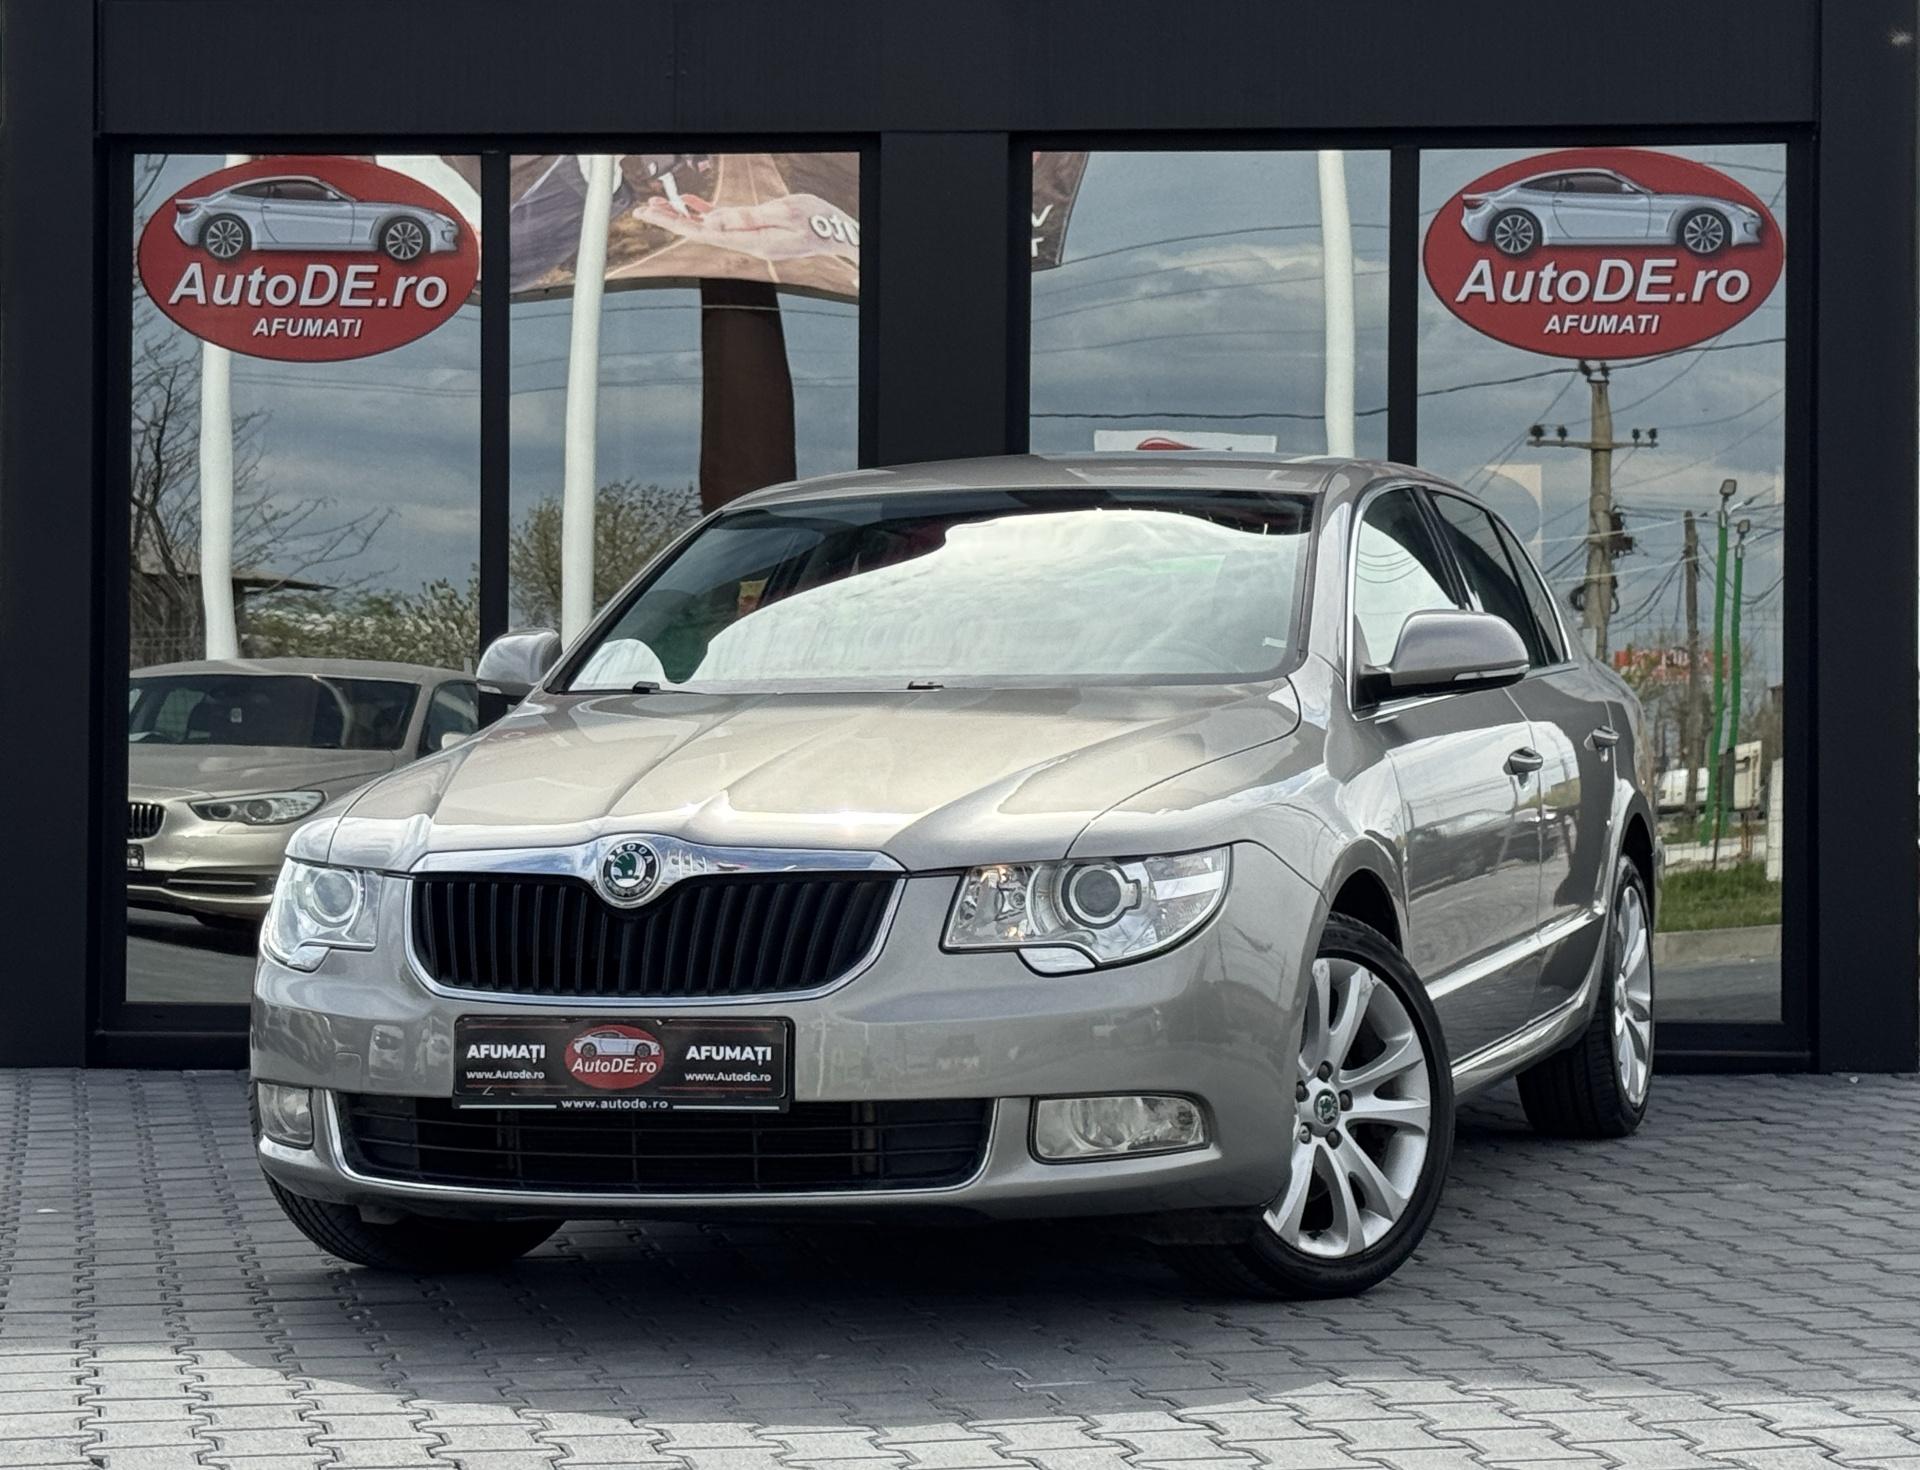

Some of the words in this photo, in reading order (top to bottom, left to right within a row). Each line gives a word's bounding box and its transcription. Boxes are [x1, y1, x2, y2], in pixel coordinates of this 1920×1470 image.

[168, 263, 448, 308] AutoDE.ro
[1455, 259, 1751, 304] AutoDE.ro
[252, 318, 363, 338] AFUMATI
[1543, 314, 1661, 334] AFUMATI
[466, 1070, 545, 1080] www.Autode.ro
[571, 1058, 657, 1074] AutoDE.ro
[684, 1071, 772, 1082] www.Autode.ro
[561, 1098, 669, 1110] www.autode.ro
